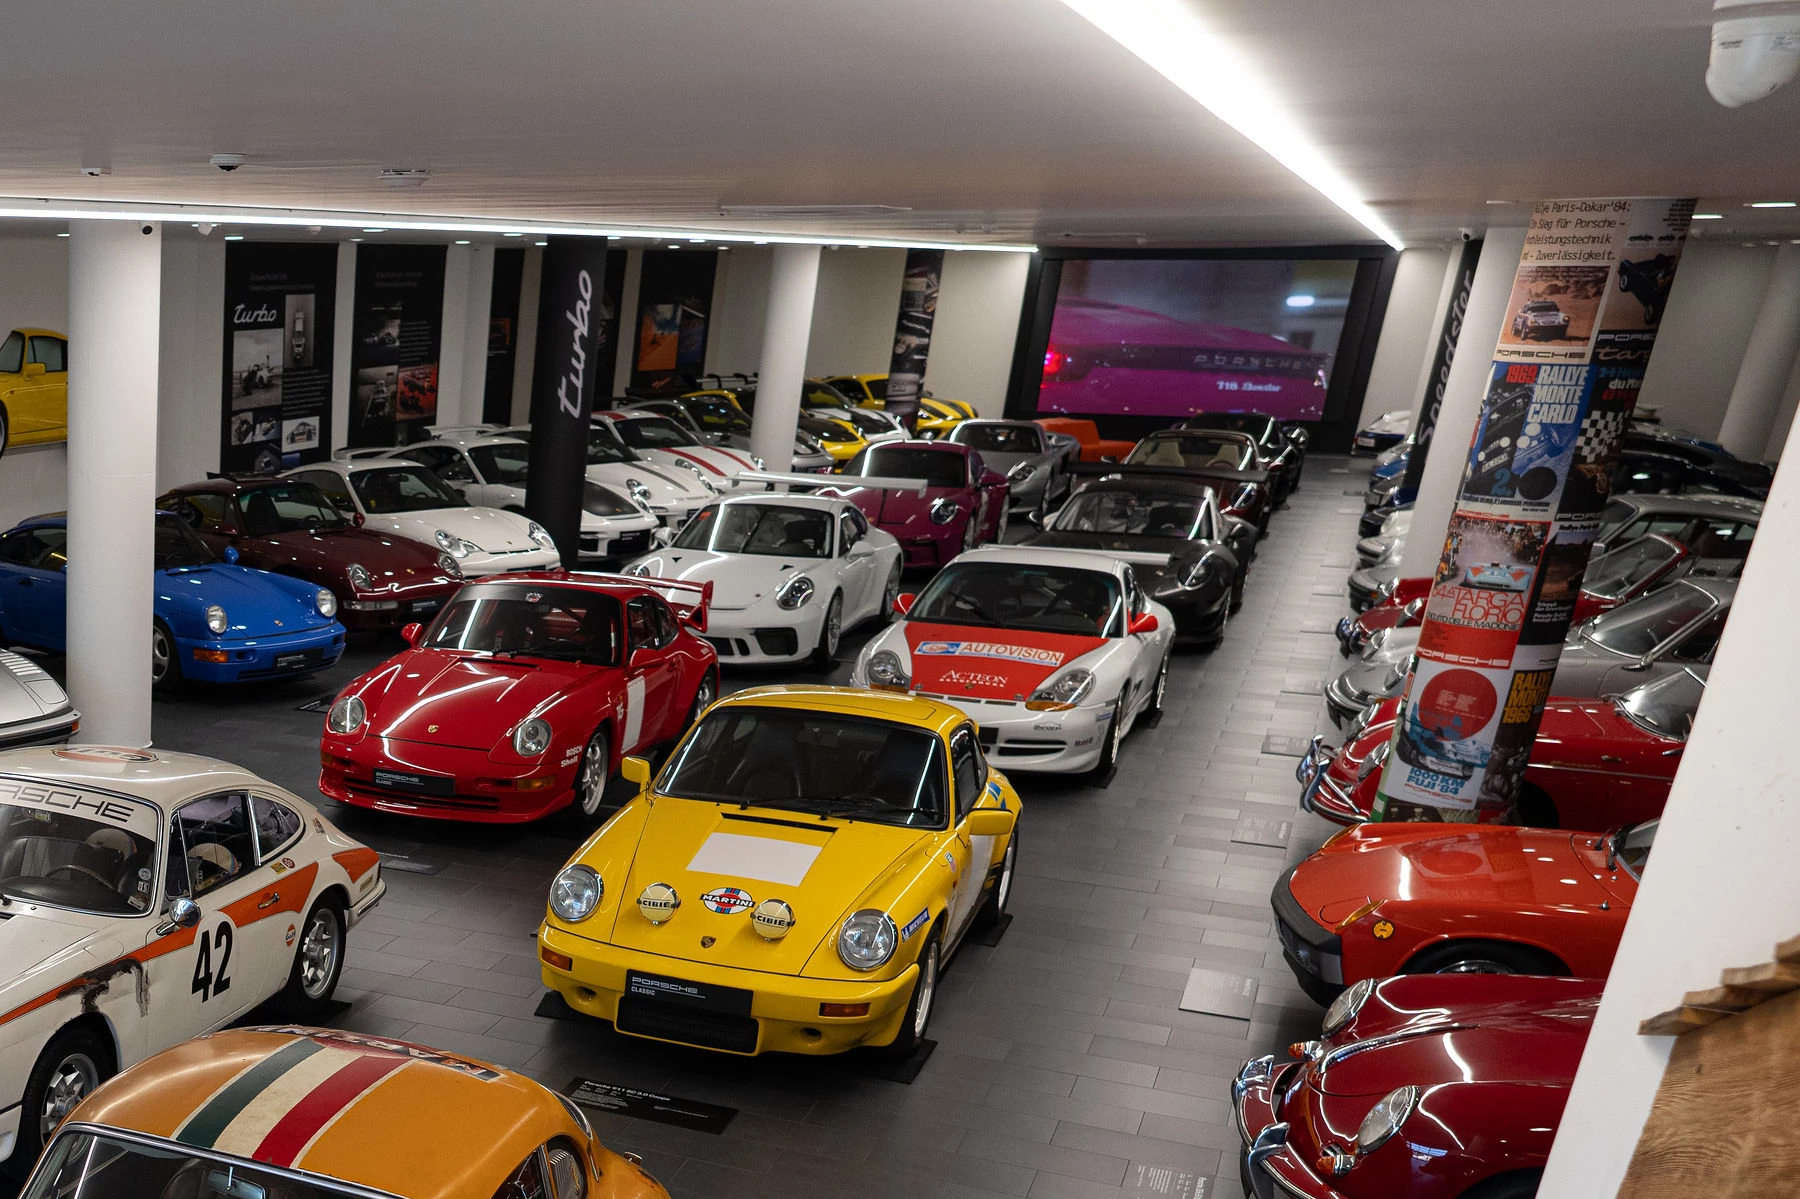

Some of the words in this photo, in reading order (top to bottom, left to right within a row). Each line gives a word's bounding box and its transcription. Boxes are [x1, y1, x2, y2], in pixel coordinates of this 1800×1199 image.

[1574, 218, 1616, 228] Porsche
[556, 269, 592, 420] turbo
[1497, 349, 1586, 359] PORSCHE
[1506, 364, 1539, 384] 1969
[1536, 364, 1589, 385] RALLYE
[1532, 385, 1584, 403] MONTE
[1526, 404, 1579, 424] CARLO
[1453, 587, 1525, 609] TARGA
[1451, 602, 1525, 623] FLORIO
[960, 642, 1062, 664] AUTOVISION
[1416, 646, 1510, 667] PORSCHE
[939, 669, 1008, 684] ACTEON
[1503, 705, 1533, 724] 1966
[565, 745, 582, 757] BOSCH
[560, 755, 578, 767] Shell
[375, 771, 420, 782] PORSCHE
[1406, 776, 1436, 791] FUJI
[1410, 767, 1439, 782] 1000
[1440, 777, 1466, 788] KM
[702, 893, 754, 907] MARTINI
[192, 920, 233, 1004] 42
[631, 976, 698, 994] PORSCHE
[631, 986, 656, 996] CLASSIC
[584, 1080, 611, 1090] Porsche
